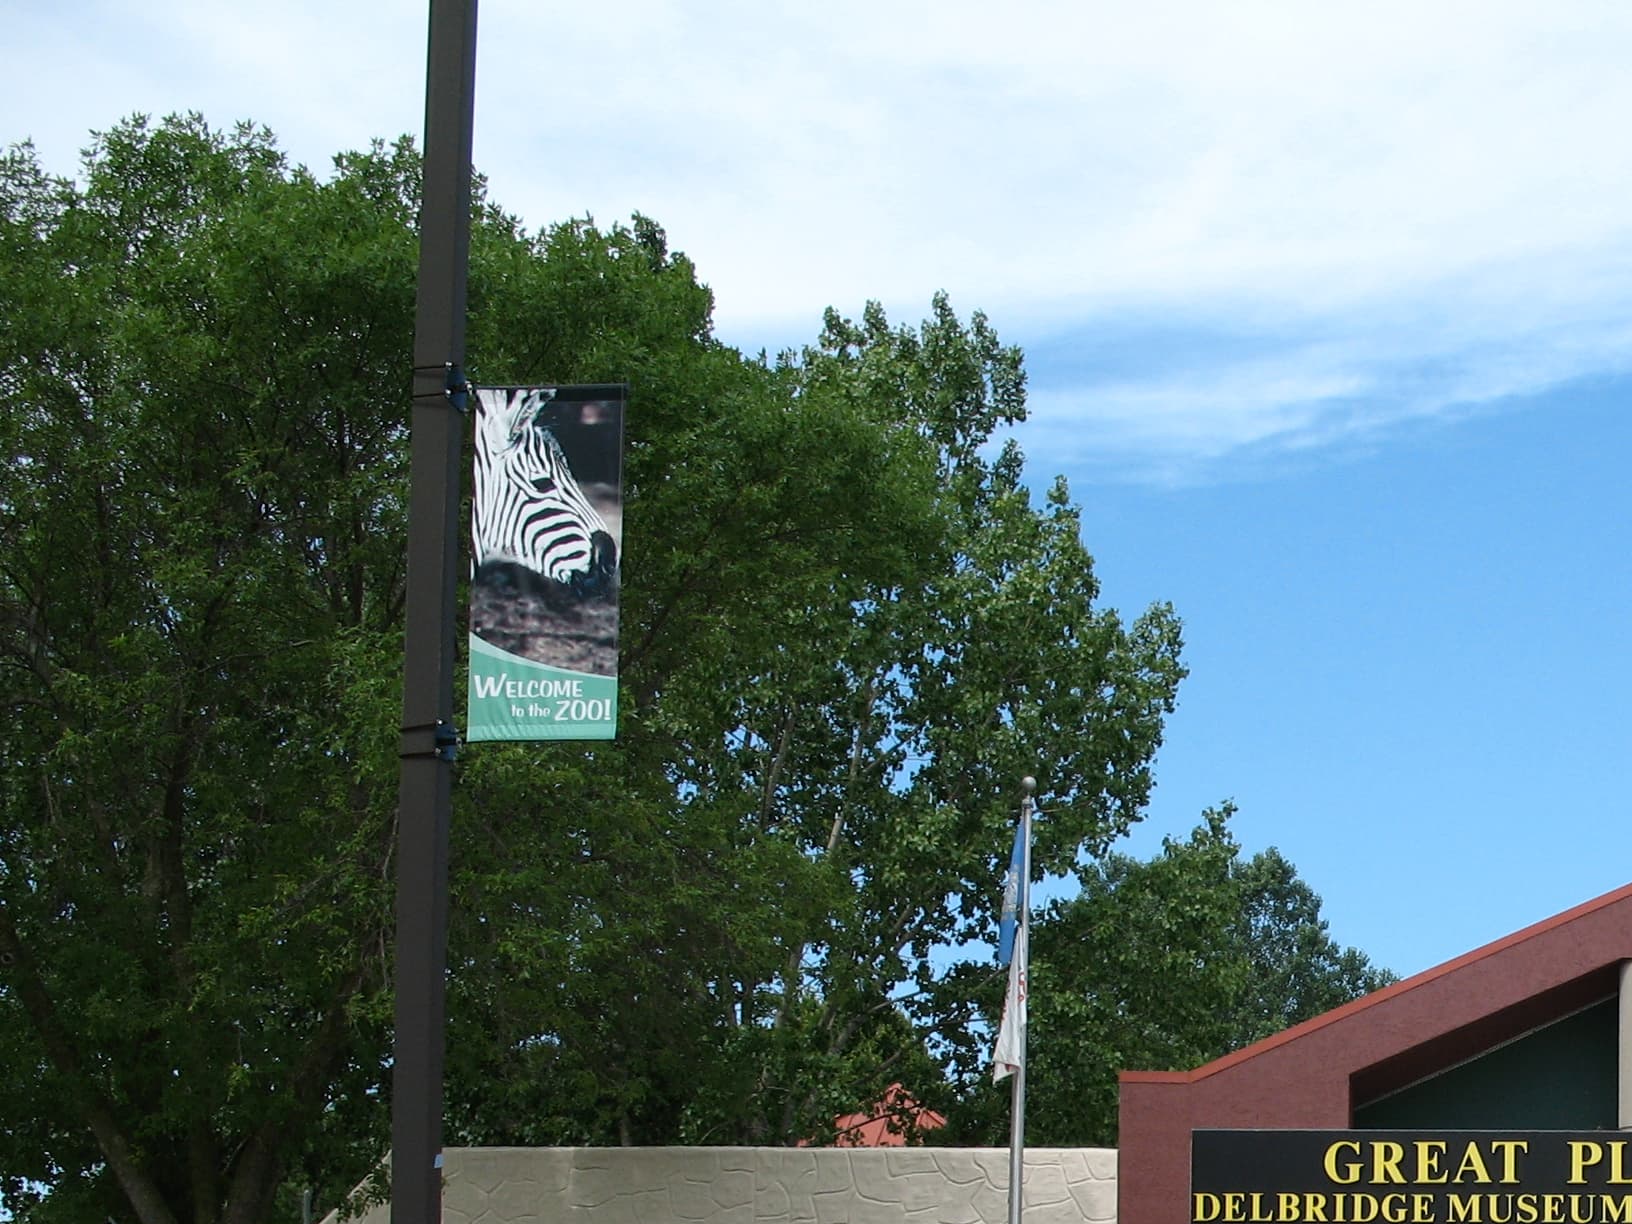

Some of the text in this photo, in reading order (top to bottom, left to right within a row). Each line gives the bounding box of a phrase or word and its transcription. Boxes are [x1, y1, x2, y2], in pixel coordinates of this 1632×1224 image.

[473, 673, 584, 699] WELCOME
[511, 699, 612, 721] to the ZOO!
[1323, 1140, 1528, 1185] GREAT
[1192, 1192, 1436, 1224] DELBRIDGE
